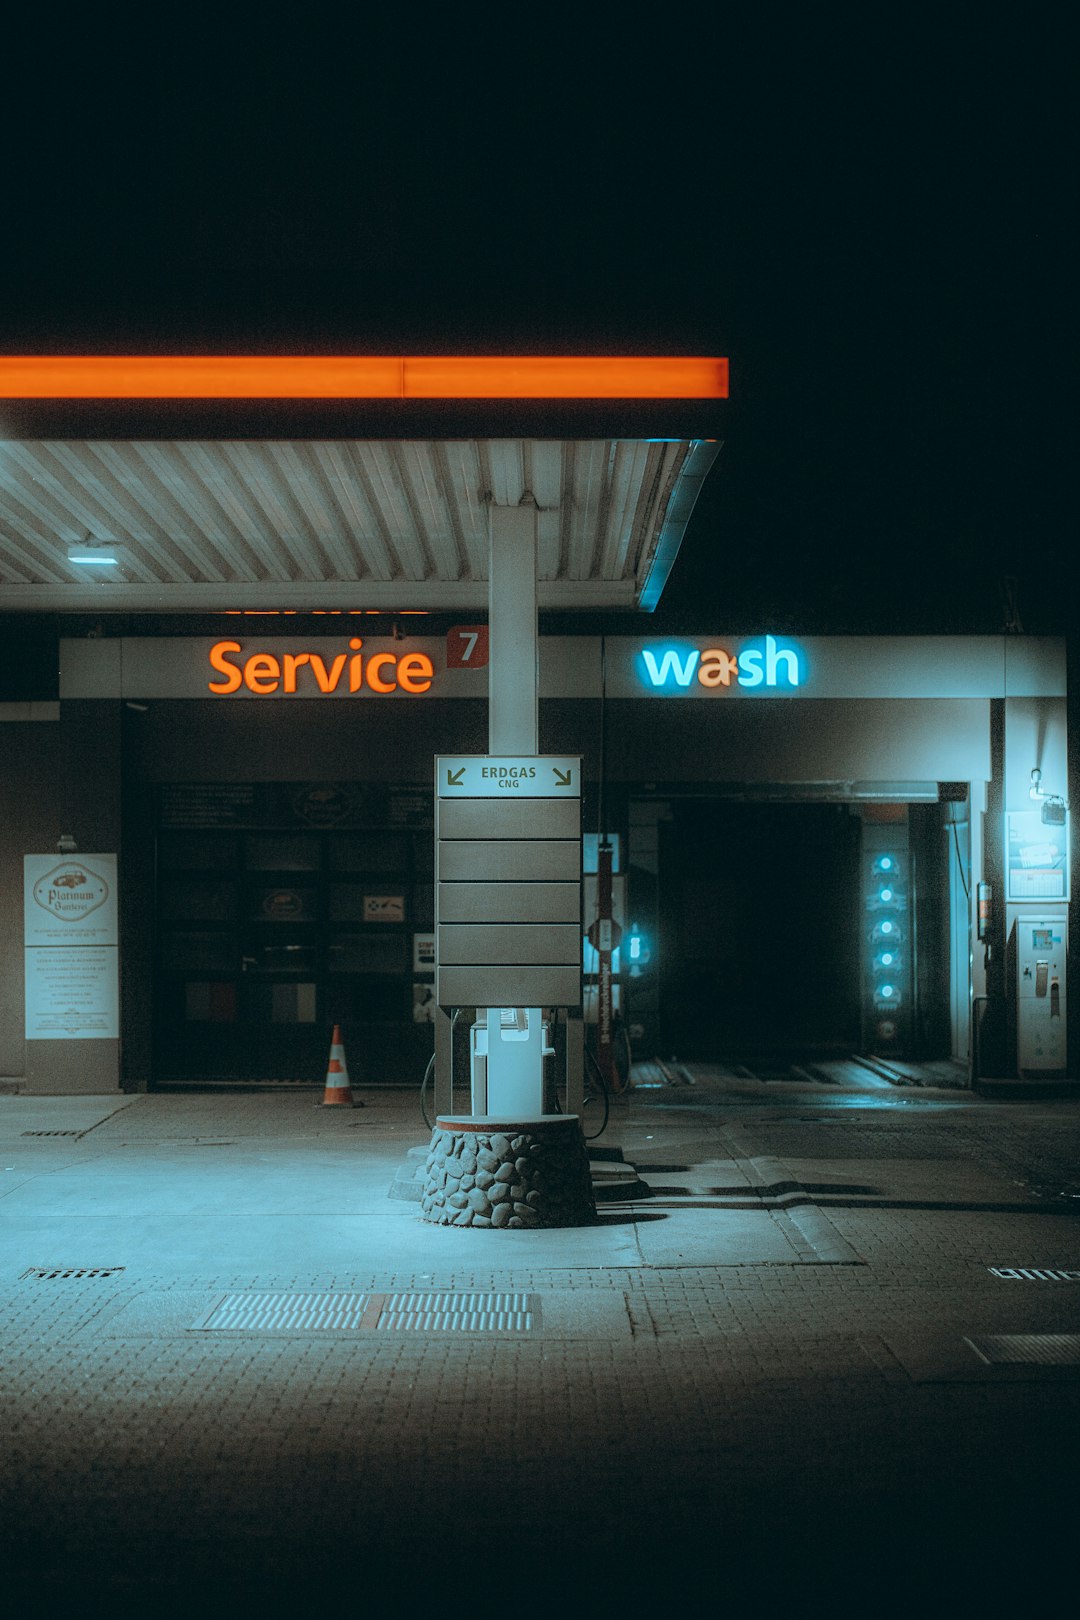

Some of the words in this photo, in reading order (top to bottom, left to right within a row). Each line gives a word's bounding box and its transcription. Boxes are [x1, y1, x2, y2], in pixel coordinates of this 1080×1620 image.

[459, 632, 479, 661] 7
[208, 637, 434, 695] Service
[642, 634, 799, 688] wash
[481, 767, 537, 778] ERDGAS
[498, 779, 520, 788] CNG
[48, 889, 94, 904] Platinum
